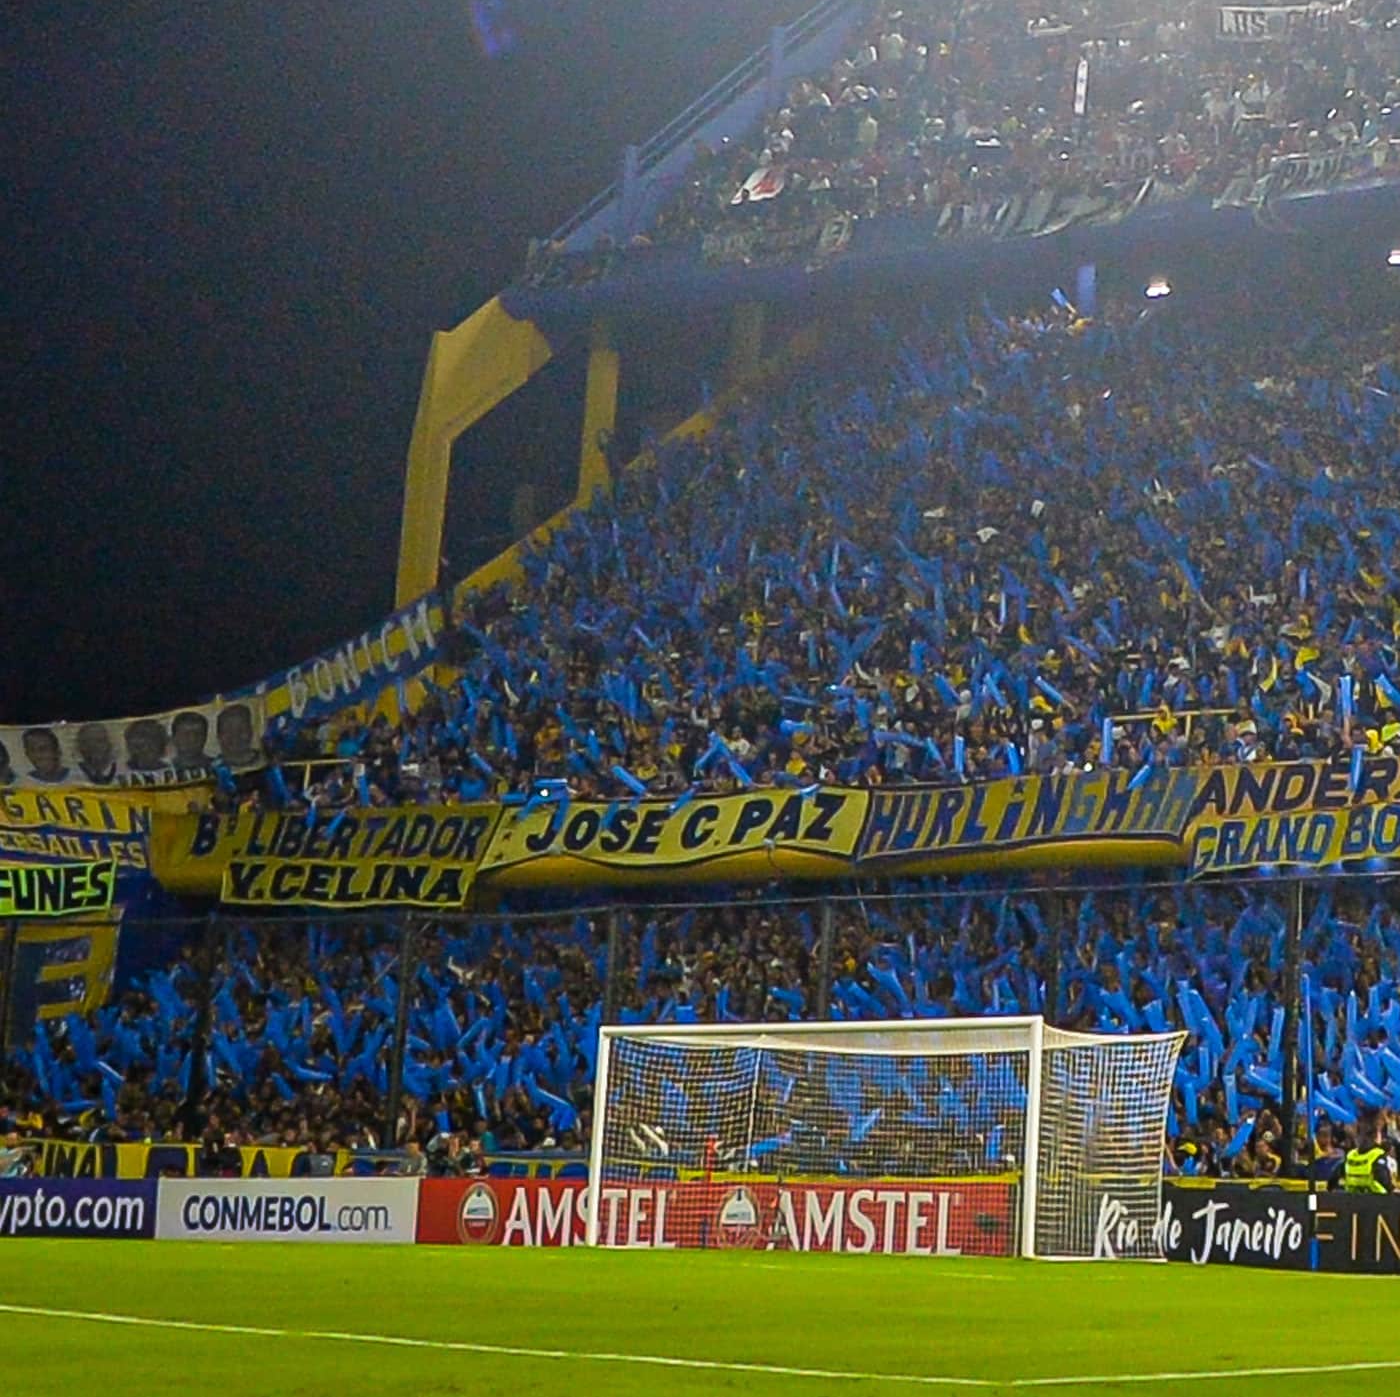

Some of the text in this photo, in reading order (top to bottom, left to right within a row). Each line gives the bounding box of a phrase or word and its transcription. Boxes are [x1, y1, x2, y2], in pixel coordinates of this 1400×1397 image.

[245, 813, 490, 860] LIBERTADOR
[525, 792, 846, 854] JOSE C. PAZ
[1192, 813, 1336, 876] GRAND
[183, 1194, 388, 1232] CONMEBOL.com
[502, 1187, 676, 1248] AMSTEL
[766, 1189, 963, 1255] AMSTEL
[1094, 1192, 1303, 1264] Rio de Janeiro
